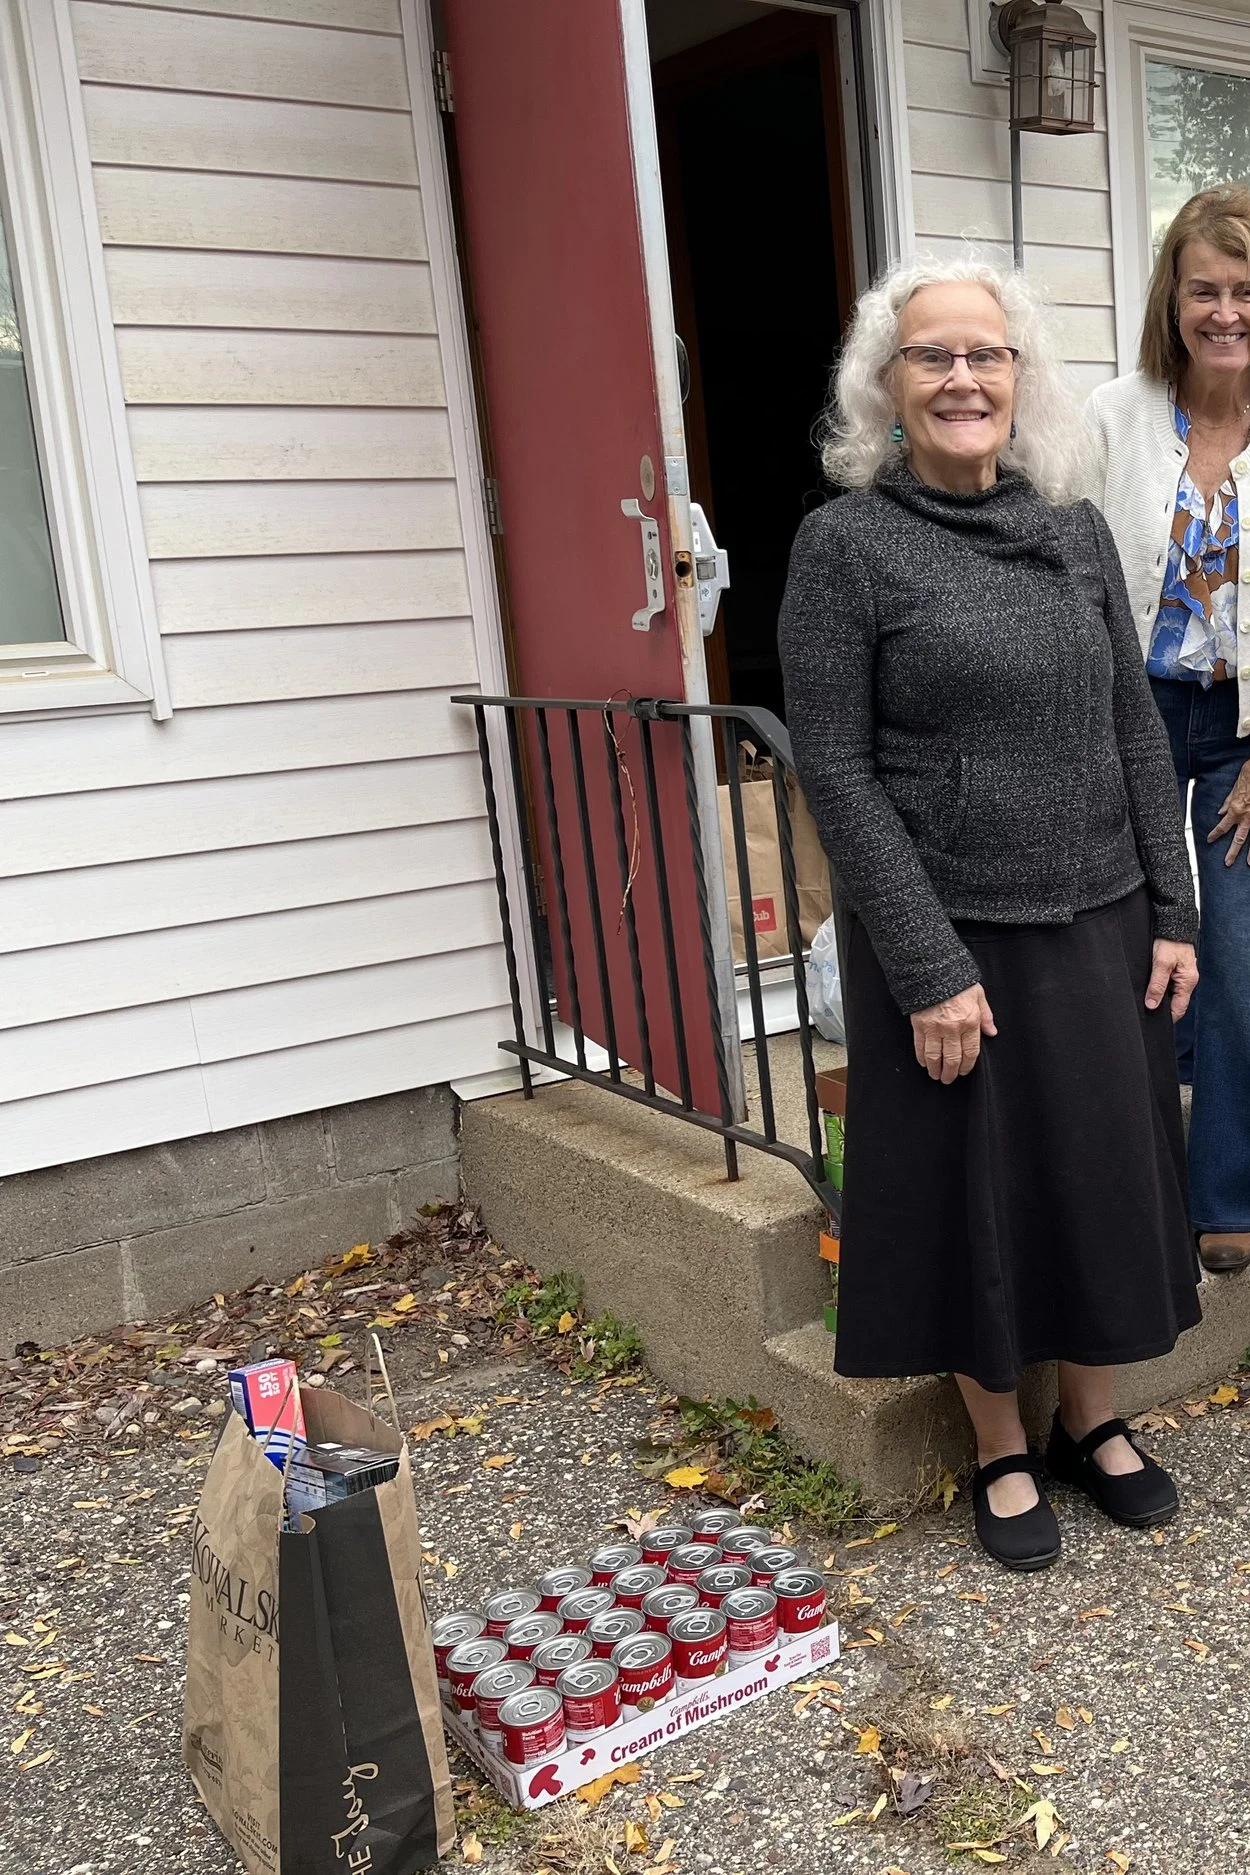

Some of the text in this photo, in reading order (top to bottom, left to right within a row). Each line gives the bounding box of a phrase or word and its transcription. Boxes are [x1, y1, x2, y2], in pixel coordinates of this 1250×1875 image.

[753, 910, 770, 922] ub
[258, 1373, 273, 1399] 150
[271, 1371, 281, 1395] SQ FT
[191, 1515, 280, 1643] KOWALSK
[205, 1591, 278, 1664] MRKET
[610, 1727, 663, 1763] Cream
[666, 1715, 683, 1735] of
[685, 1676, 768, 1727] Mushroom
